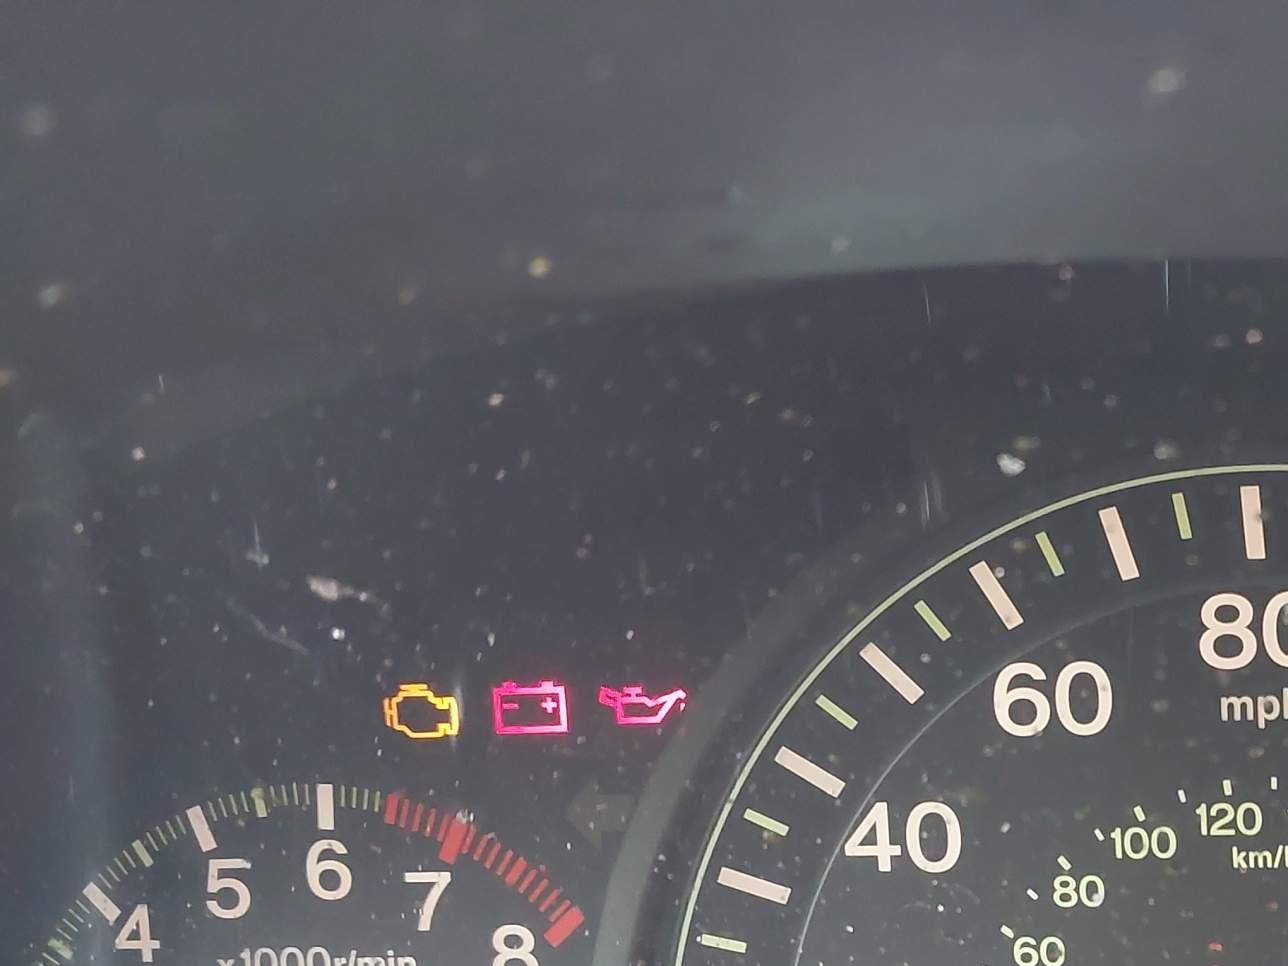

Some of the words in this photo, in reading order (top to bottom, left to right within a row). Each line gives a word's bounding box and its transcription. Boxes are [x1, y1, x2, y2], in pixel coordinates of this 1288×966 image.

[993, 661, 1113, 737] 60
[844, 801, 962, 873] 40
[1110, 826, 1177, 860] 100
[1196, 803, 1263, 837] 120
[205, 858, 251, 919] 5
[306, 840, 353, 900] 6
[1052, 875, 1105, 908] 80
[404, 871, 451, 930] 7
[114, 905, 160, 962] 4
